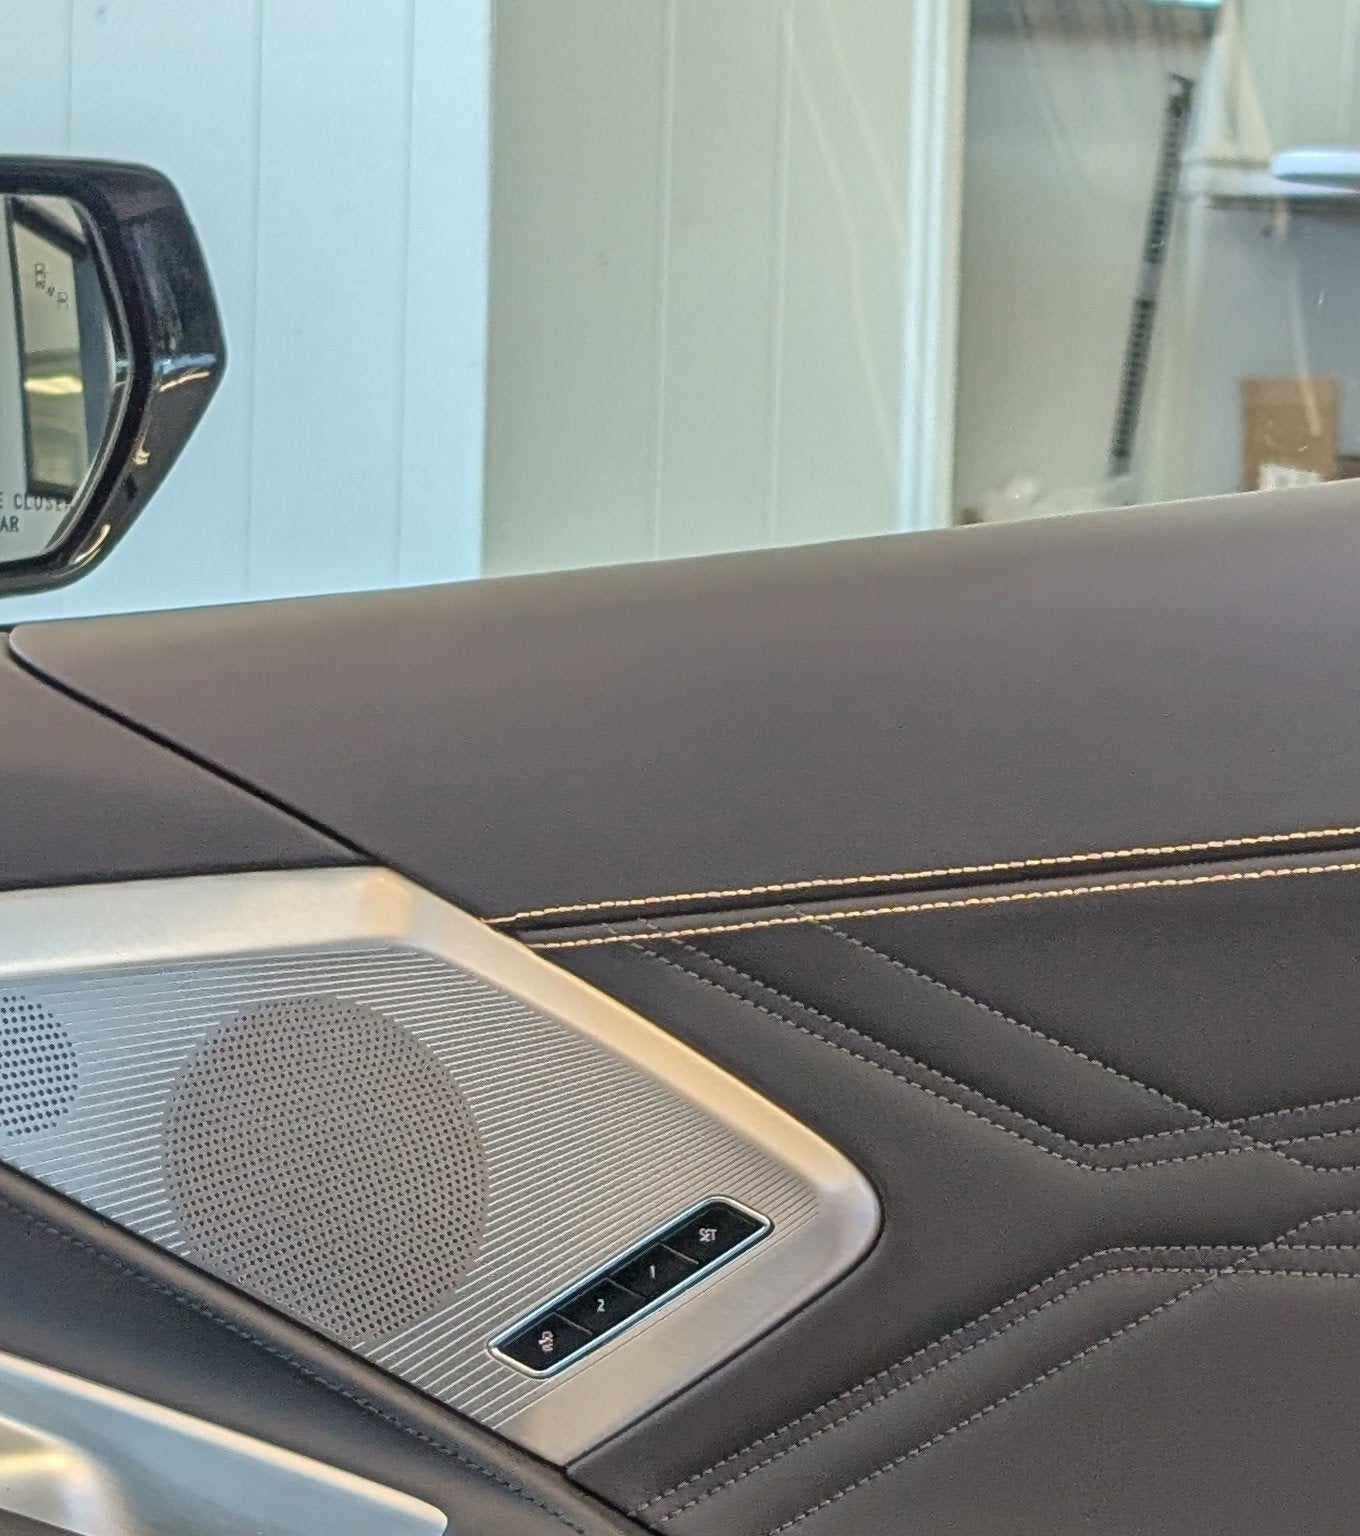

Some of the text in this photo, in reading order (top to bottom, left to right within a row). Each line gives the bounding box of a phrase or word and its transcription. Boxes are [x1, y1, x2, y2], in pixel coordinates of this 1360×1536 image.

[14, 492, 68, 512] CLOSE
[699, 1227, 717, 1242] SET
[649, 1264, 656, 1280] 1
[596, 1298, 606, 1314] 2
